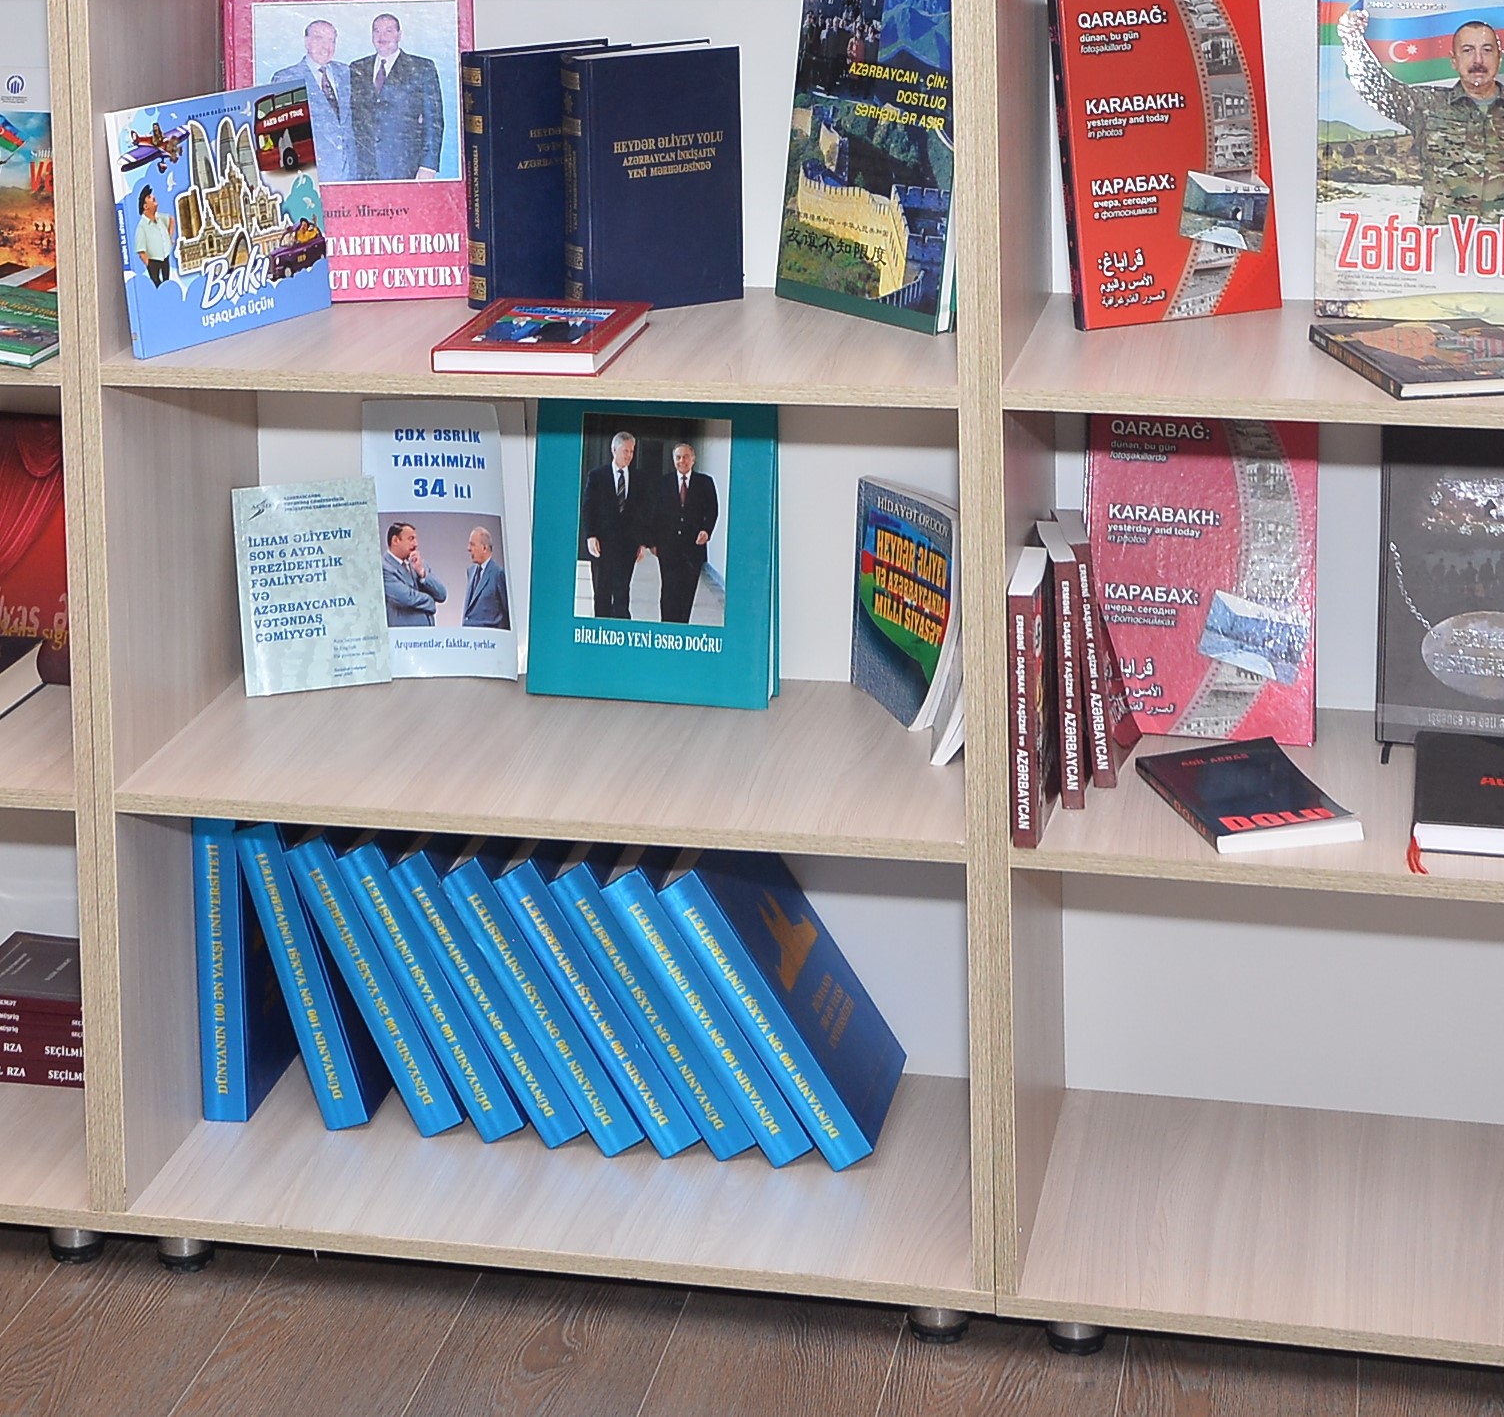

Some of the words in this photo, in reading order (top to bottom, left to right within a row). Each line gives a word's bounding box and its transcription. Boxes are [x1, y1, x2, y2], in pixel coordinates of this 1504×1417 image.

[1078, 6, 1168, 29] QARABAĞ:
[849, 62, 919, 85] AZƏRBAYCAN
[926, 72, 948, 90] ÇİN:
[896, 90, 947, 111] DOSTLUQ
[1085, 93, 1185, 114] KARABAKH:
[854, 103, 918, 127] SƏRHƏDLƏR
[920, 114, 945, 131] AŞIR
[1086, 116, 1127, 128] yesterday
[1129, 115, 1144, 124] and
[1146, 113, 1169, 123] today
[613, 138, 656, 153] HEYDƏR
[658, 134, 694, 148] ƏLİYEV
[697, 131, 724, 144] YOLU
[622, 152, 677, 166] AZƏRBAYCAN
[678, 148, 716, 161] İNKİŞAFIN
[628, 168, 647, 179] YENİ
[650, 161, 712, 176] MƏRHƏLƏSİNDƏ
[1091, 174, 1176, 195] КАРАБАХ:
[356, 205, 409, 220] Mirzayev
[409, 233, 460, 254] FROM
[786, 227, 887, 266] 友谊不知限度
[1337, 211, 1440, 272] Zəfər
[200, 245, 270, 308] Bakı
[355, 268, 378, 288] OF
[383, 266, 465, 288] CENTURY
[202, 306, 246, 328] UŞAQLAR
[248, 297, 275, 314] ÜÇÜN
[394, 428, 426, 444] ÇOX
[433, 428, 481, 444] ƏSRLİK
[392, 453, 485, 470] TARİXİMİZİN
[413, 478, 447, 498] 34
[454, 483, 472, 498] İLİ
[877, 495, 917, 524] HİDAYƏT
[247, 535, 289, 548] İLHAM
[293, 528, 352, 544] ƏLİYEVİN
[249, 551, 275, 561] SON
[279, 549, 286, 558] 6
[290, 546, 325, 558] AYDA
[876, 529, 916, 571] HEYDƏR
[250, 556, 343, 574] PREZİDENTLİK
[251, 571, 327, 589] FƏALİYYƏTİ
[252, 591, 270, 602] VƏ
[253, 596, 355, 616] AZƏRBAYCANDA
[254, 613, 323, 629] VƏTƏNDAŞ
[874, 592, 903, 627] MİLLİ
[904, 608, 943, 646] SİYASƏT
[256, 627, 327, 643] CƏMİYYƏTİ
[574, 625, 624, 647] BİRLİKDƏ
[627, 631, 652, 649] YENİ
[654, 634, 683, 650] ƏSRƏ
[684, 633, 724, 653] DOĞRU
[1090, 693, 1109, 770] AZƏRBAYCAN
[1064, 712, 1078, 791] AZƏRBAYCAN
[1017, 748, 1029, 830] AZƏRBAYCAN
[1218, 807, 1336, 831] DOLU
[206, 844, 222, 937] UNİVERSİTETİ
[214, 1003, 225, 1022] 100
[4, 1043, 22, 1053] RZA
[215, 1026, 229, 1095] DÜNYANIN
[7, 1067, 26, 1077] RZA
